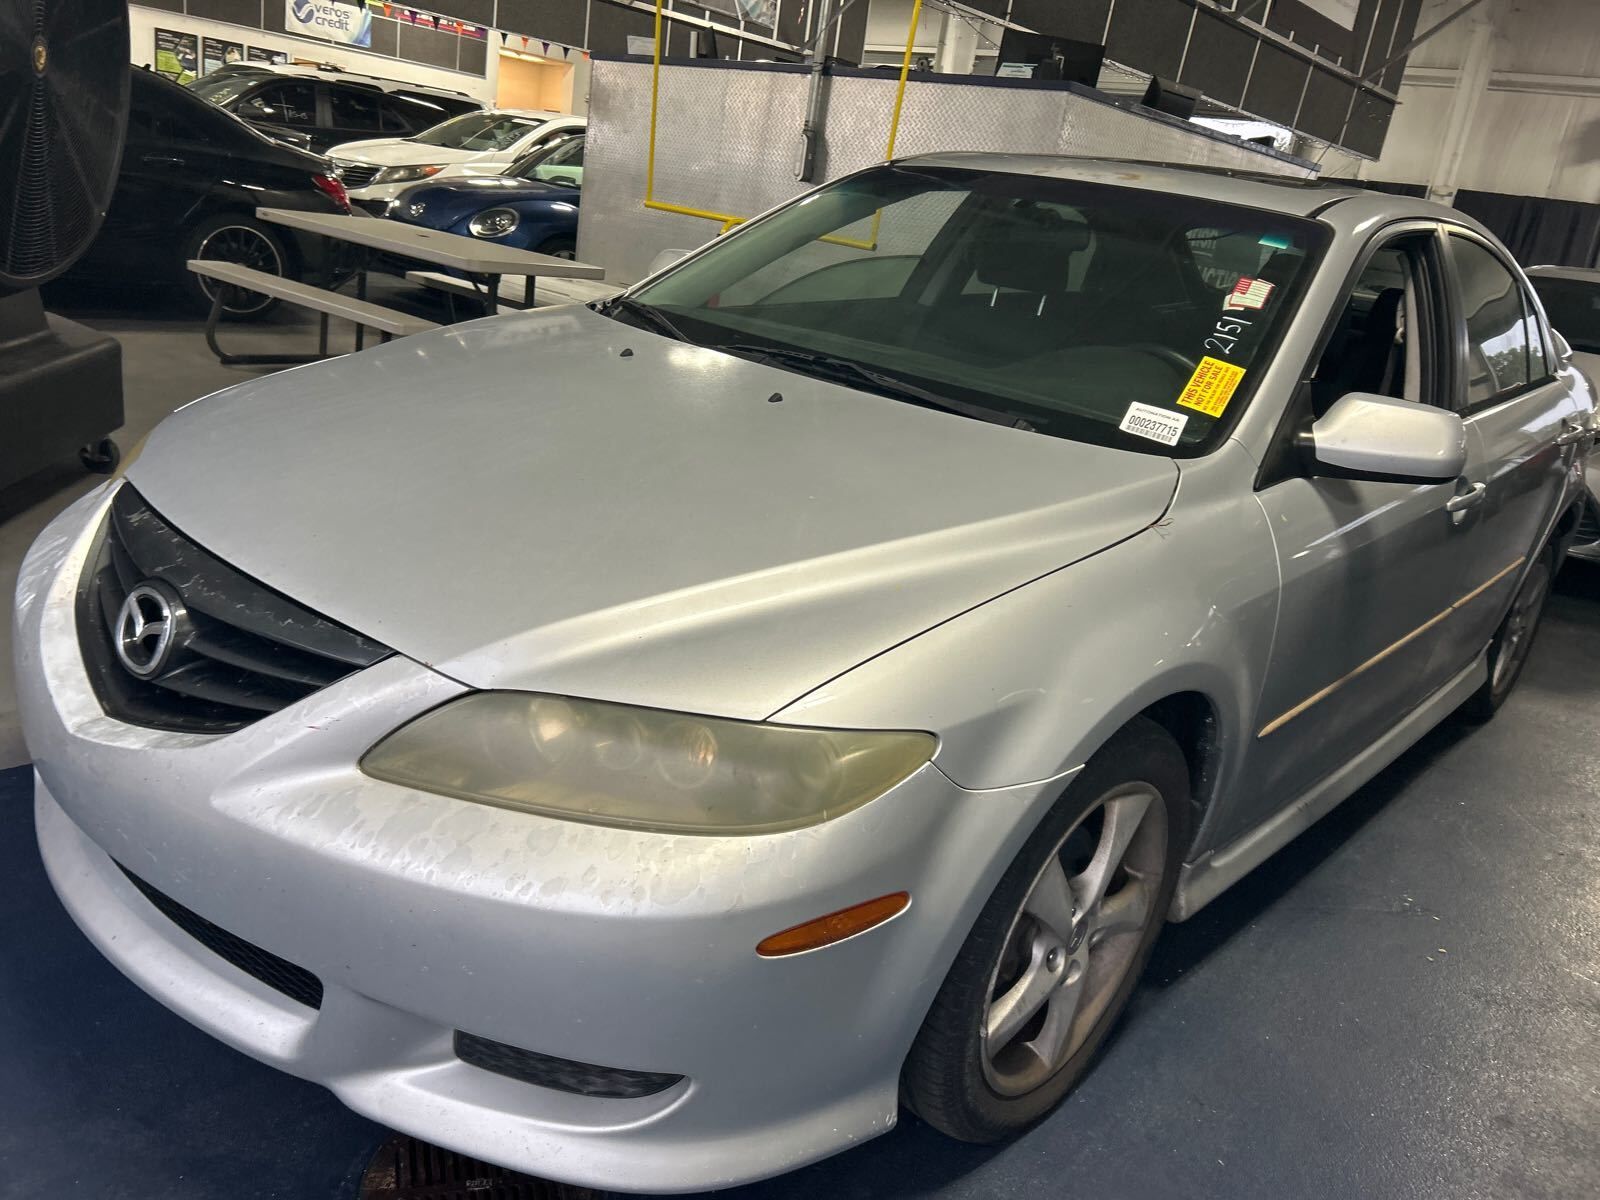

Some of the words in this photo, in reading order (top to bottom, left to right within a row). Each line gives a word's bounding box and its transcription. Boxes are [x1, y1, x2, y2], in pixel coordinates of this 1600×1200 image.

[314, 4, 350, 19] veros
[315, 16, 350, 31] credit
[1204, 316, 1252, 354] 2151
[1182, 388, 1198, 404] THIS
[1192, 360, 1215, 388] VEHICLE
[1194, 392, 1206, 406] NOT
[1201, 381, 1214, 394] FOR
[1211, 365, 1223, 381] SALE
[1128, 415, 1179, 437] 000237715
